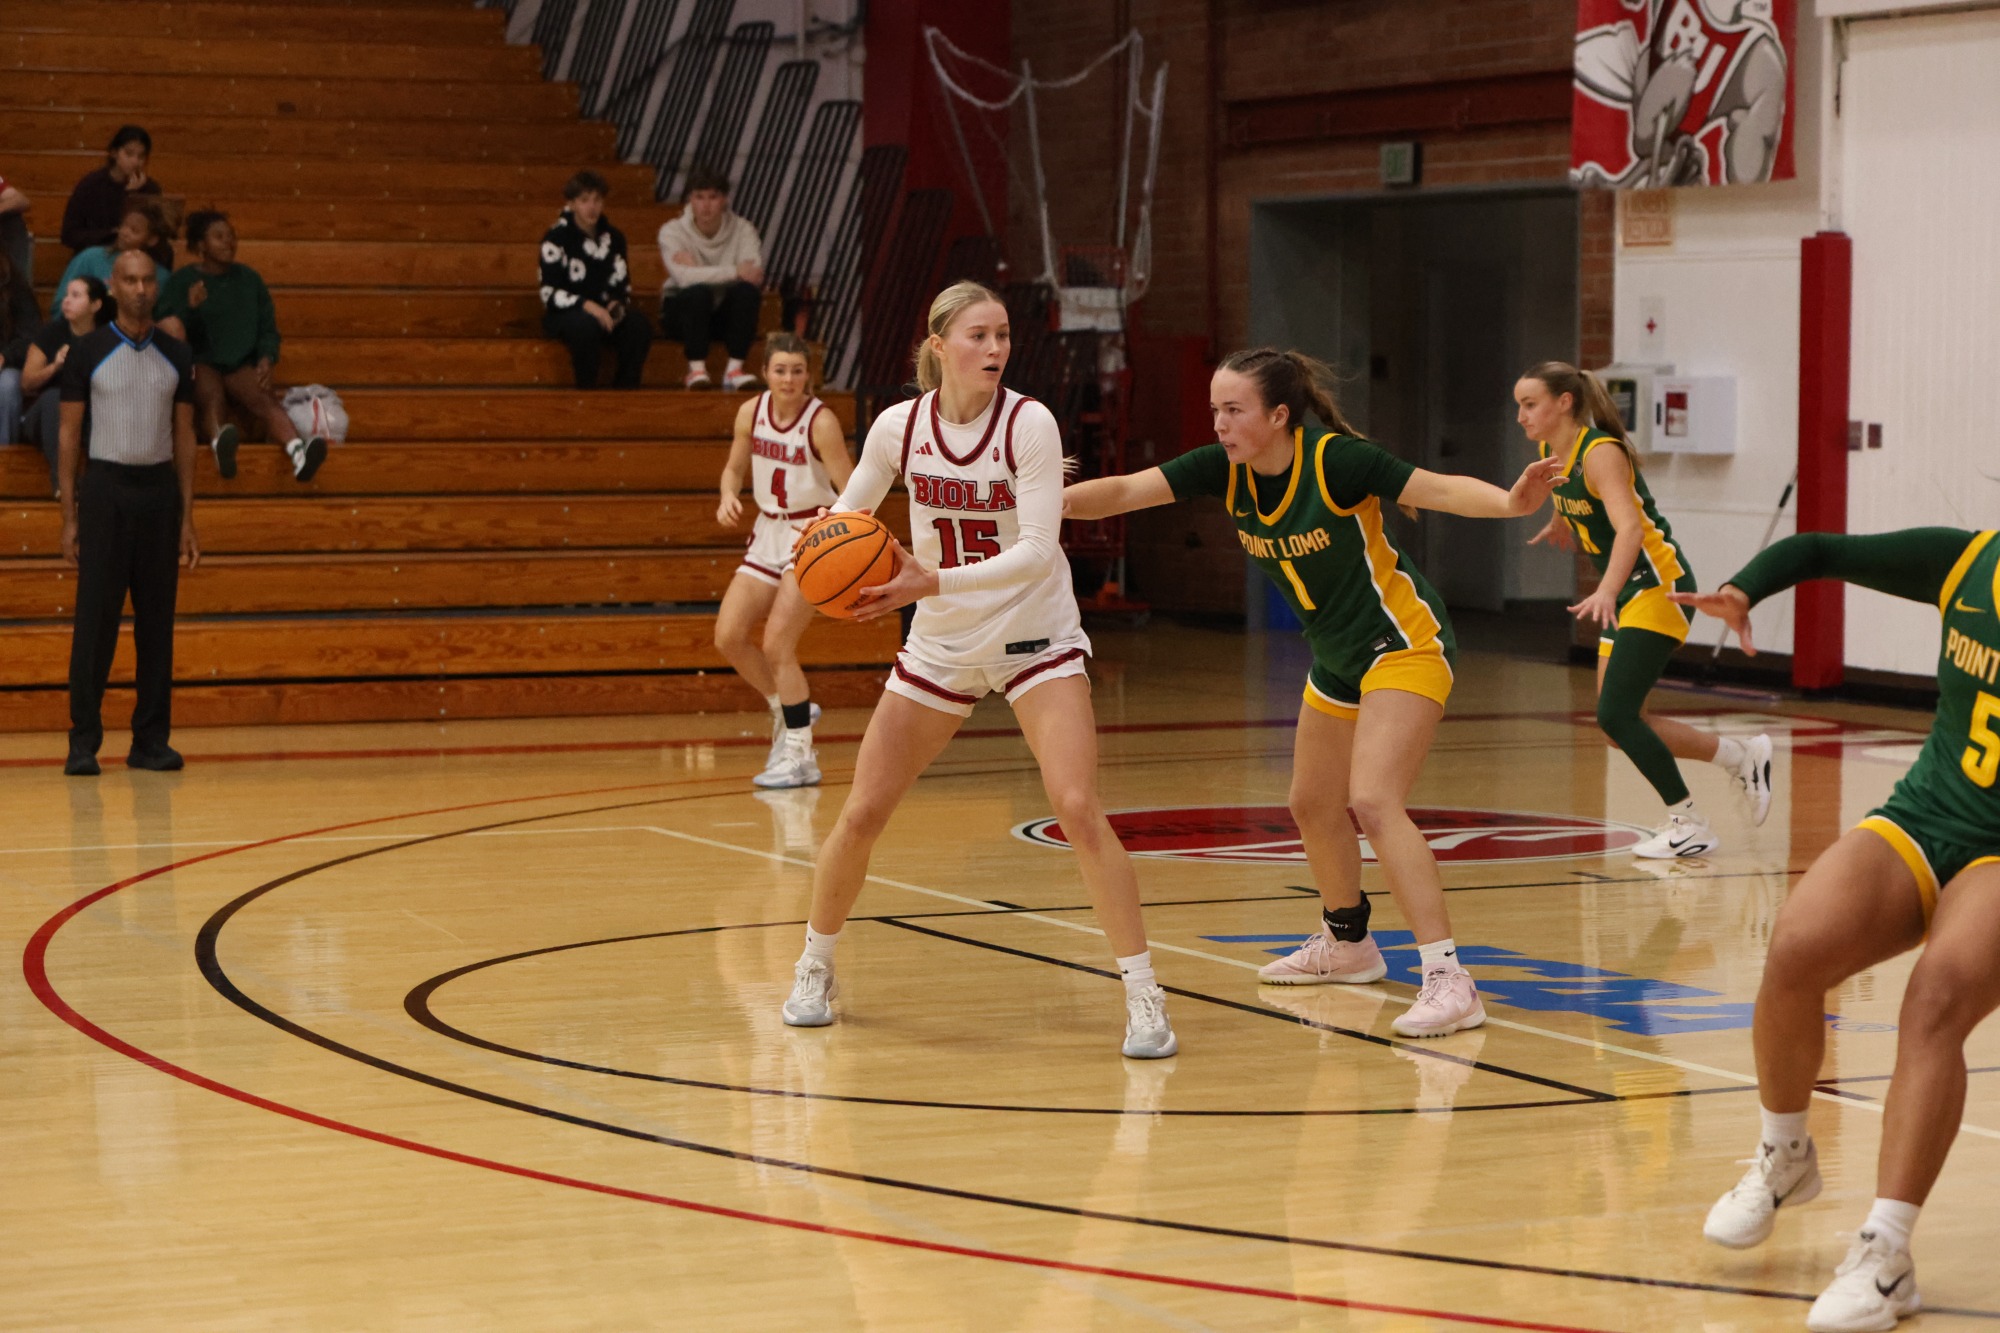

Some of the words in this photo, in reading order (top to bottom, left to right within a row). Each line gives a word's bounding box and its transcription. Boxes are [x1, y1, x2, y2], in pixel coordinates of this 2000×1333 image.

[752, 436, 807, 465] BIOLA
[771, 467, 788, 509] 4
[911, 472, 1016, 512] BIOLA
[932, 518, 1001, 569] 15
[1238, 529, 1277, 558] POINT
[1278, 528, 1331, 558] LOMA
[1279, 560, 1317, 610] 1
[1945, 626, 2000, 685] POINT
[1960, 690, 2000, 788] 5
